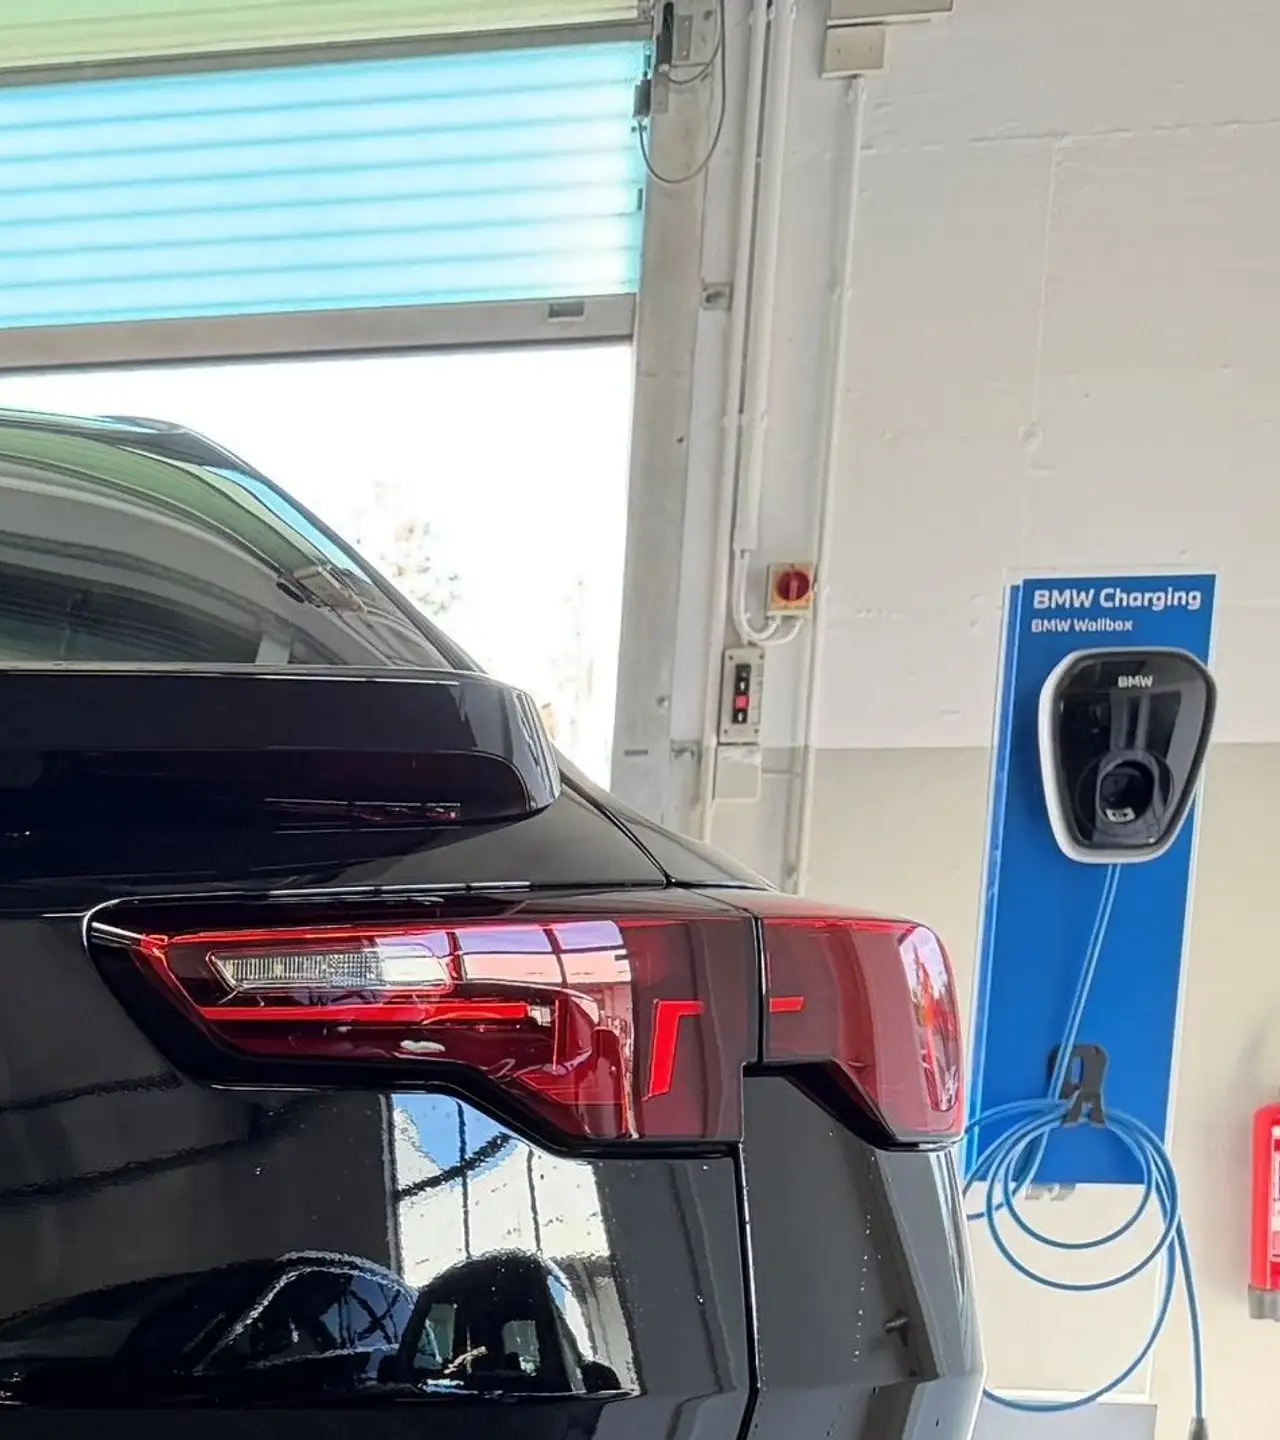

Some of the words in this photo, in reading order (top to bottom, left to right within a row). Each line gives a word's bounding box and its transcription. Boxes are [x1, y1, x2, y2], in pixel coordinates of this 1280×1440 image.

[1033, 589, 1094, 609] BMW
[1099, 587, 1202, 610] Charging
[1031, 618, 1070, 633] BMW
[1074, 617, 1134, 632] Wallbox
[1117, 675, 1153, 688] BMW
